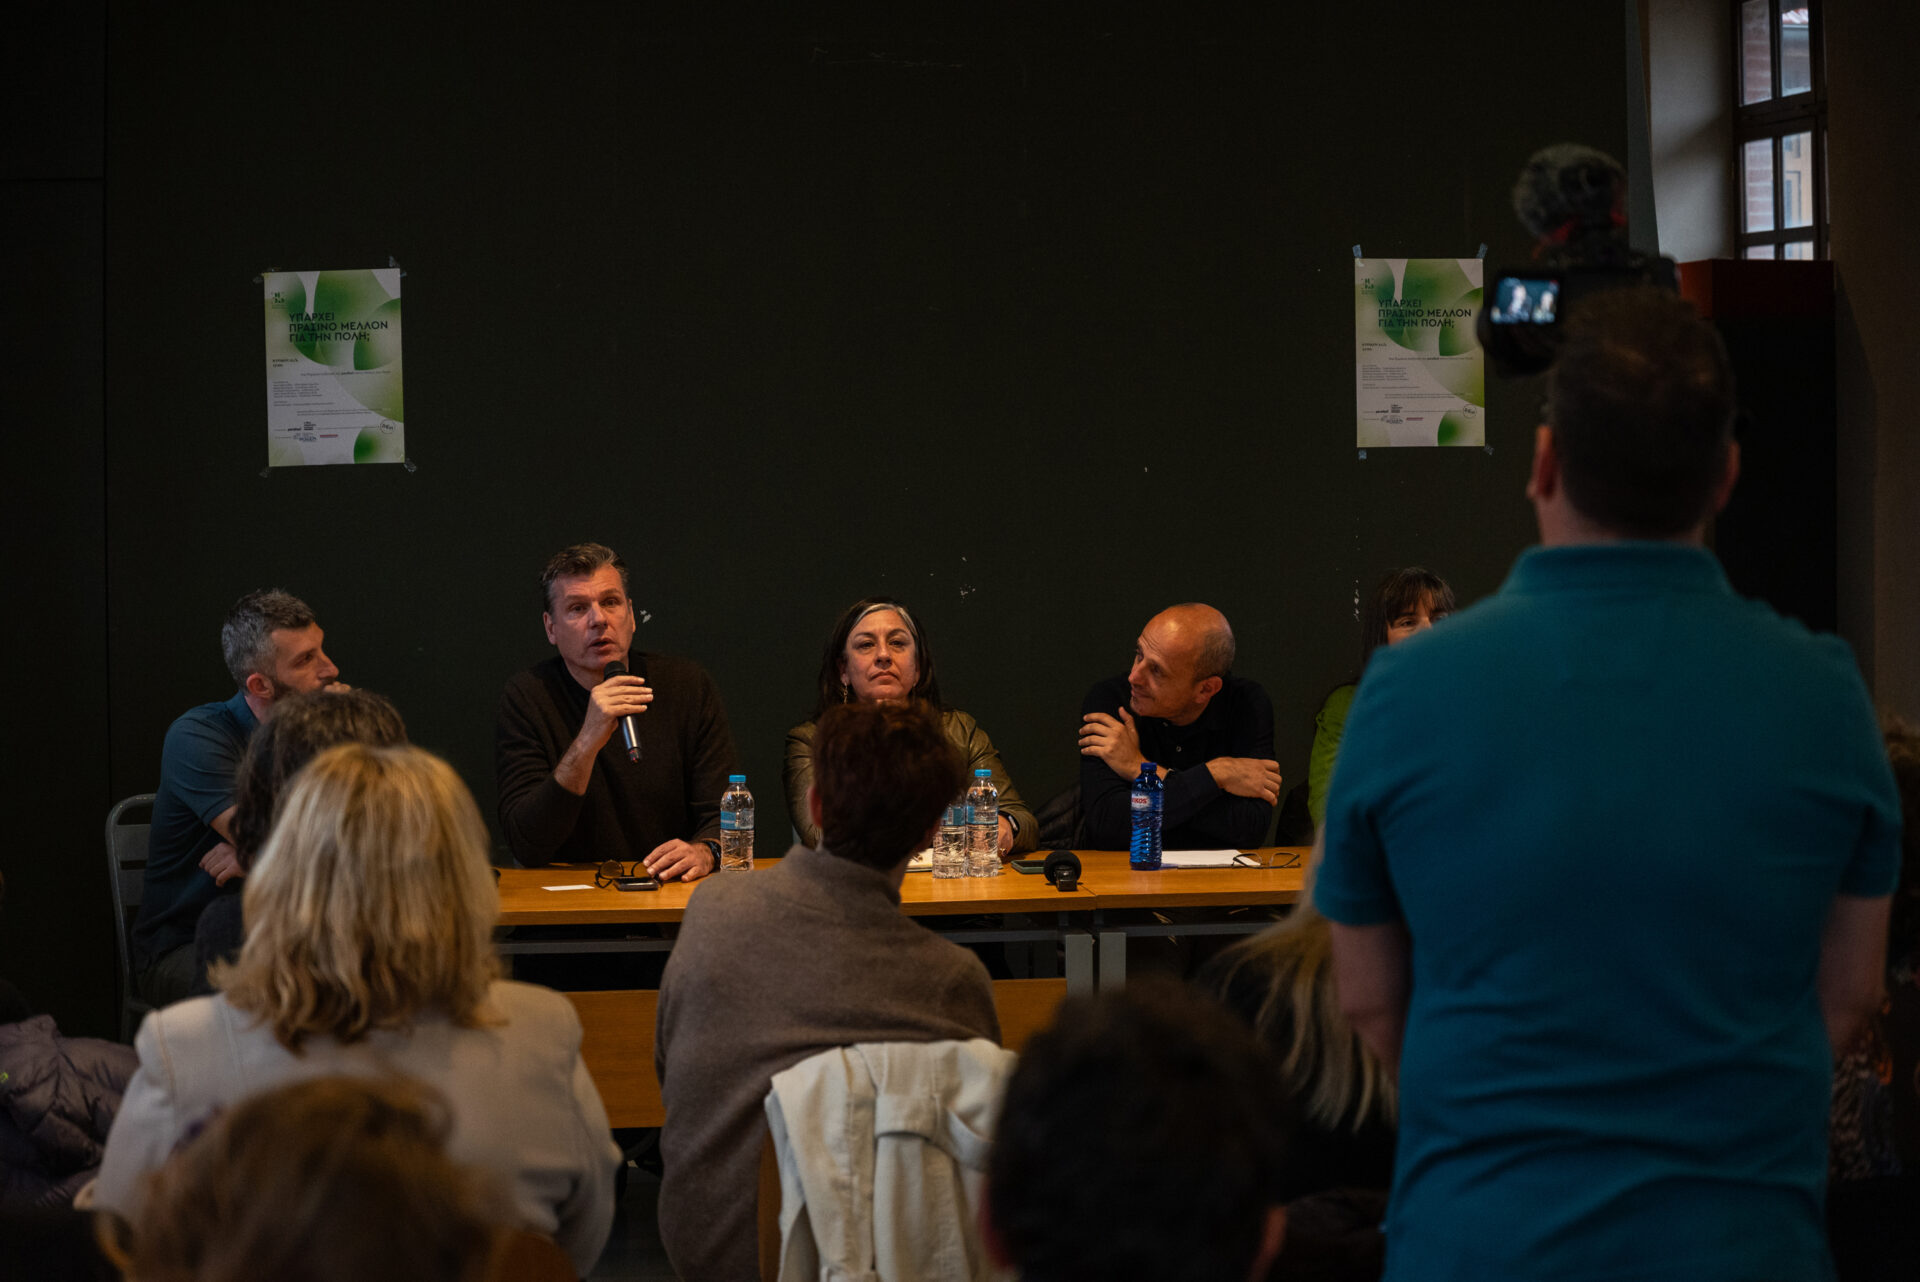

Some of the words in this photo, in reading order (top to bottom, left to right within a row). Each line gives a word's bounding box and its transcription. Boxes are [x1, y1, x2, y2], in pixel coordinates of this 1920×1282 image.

[1379, 299, 1422, 308] ΥΠΑΡΧΕΙ
[289, 312, 335, 322] ΥΠΑΡΧΕΙ
[1378, 309, 1424, 318] ΠΡΑΣΙΝΟ
[1427, 308, 1472, 317] ΜΕΛΛΟΝ
[289, 322, 338, 332] ΠΡΑΣΙΝΟ
[341, 321, 388, 330] ΜΕΛΛΟΝ
[1379, 319, 1394, 328] ΓΙΑ
[1397, 318, 1418, 328] ΤΗΝ
[1421, 318, 1455, 328] ΠΟΛΗ;
[289, 333, 306, 343] ΓΙΑ
[308, 332, 331, 342] ΤΗΝ
[335, 331, 370, 342] ΠΟΛΗ;
